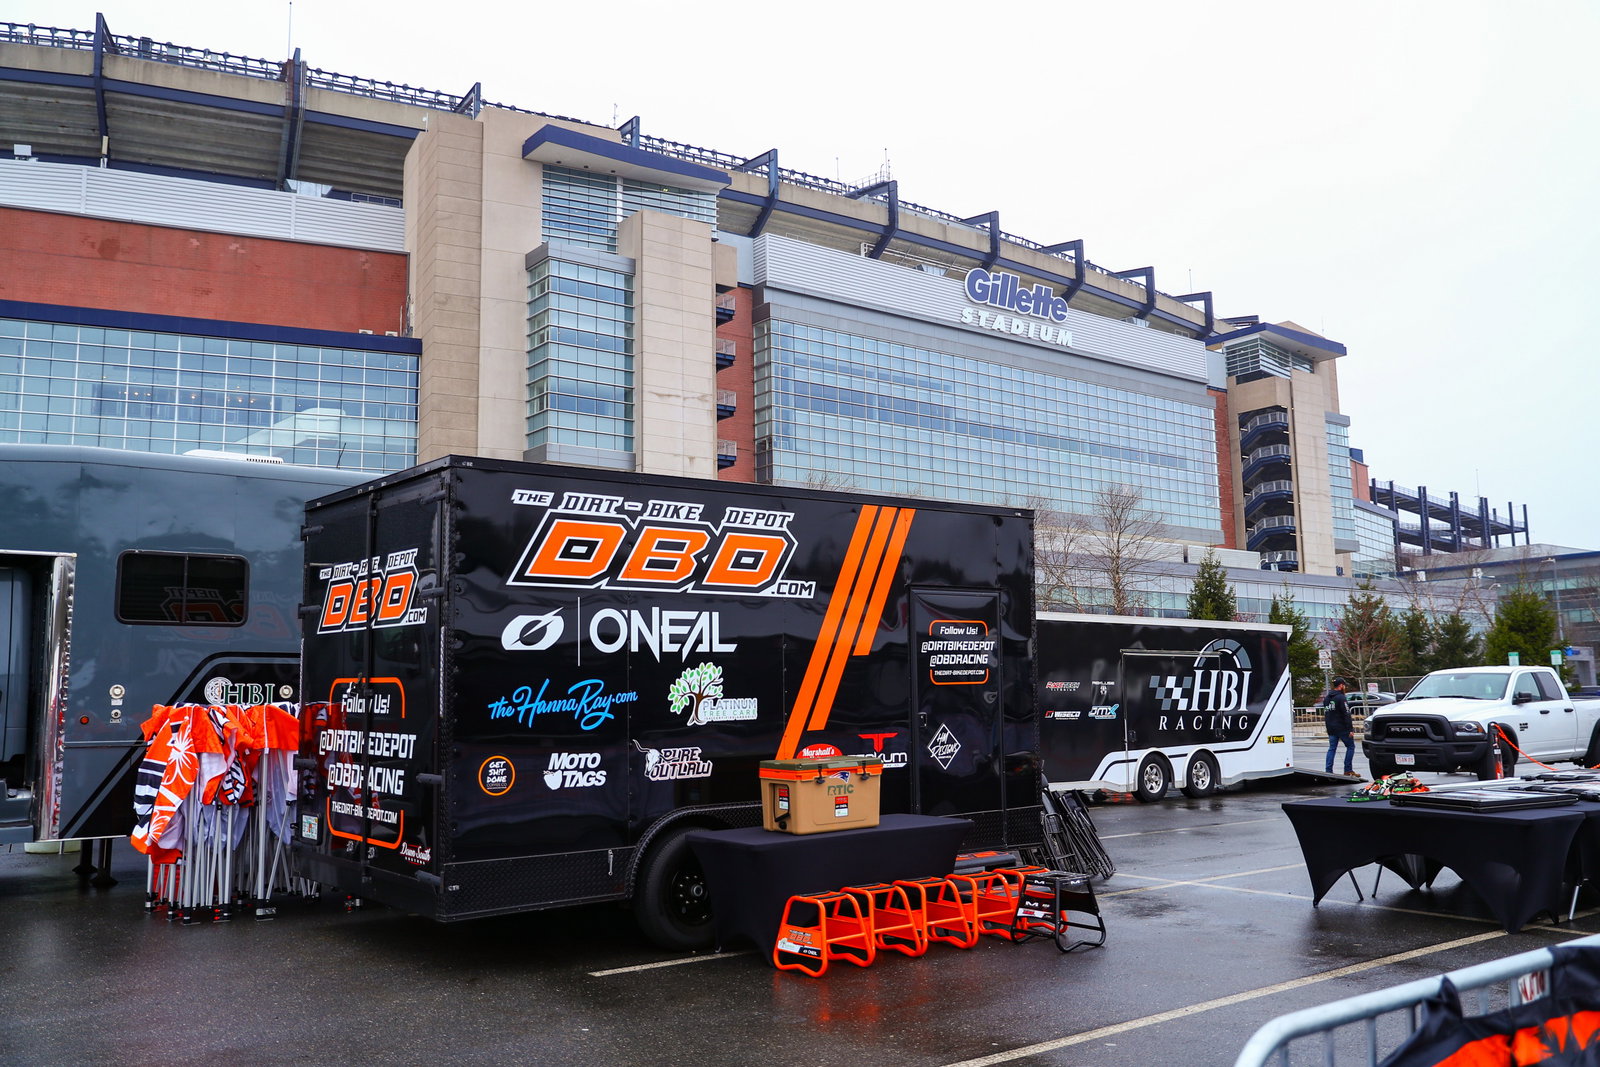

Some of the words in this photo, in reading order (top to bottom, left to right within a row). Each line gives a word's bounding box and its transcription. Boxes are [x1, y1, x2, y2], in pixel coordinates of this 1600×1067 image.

[965, 268, 1068, 323] Gillette
[961, 307, 1073, 347] STADIUM
[513, 490, 553, 506] THE
[724, 507, 794, 530] DEPOT
[513, 514, 795, 592] DBD
[320, 568, 331, 578] THE
[387, 550, 417, 568] DEPOT
[940, 626, 965, 635] Follow
[966, 627, 978, 635] Us!
[921, 641, 995, 653] @DIRTBIKEDEPOT
[930, 654, 989, 667] @DBDRACING
[223, 683, 275, 705] HBI
[1189, 669, 1252, 712] HBI
[373, 694, 391, 714] Us!
[702, 699, 757, 711] PLATINUM
[1158, 714, 1249, 731] RACING
[489, 761, 506, 769] GET
[548, 752, 602, 770] MOTO
[563, 770, 607, 788] TAGS
[649, 761, 713, 780] OUTLAW
[827, 784, 854, 796] RTIC
